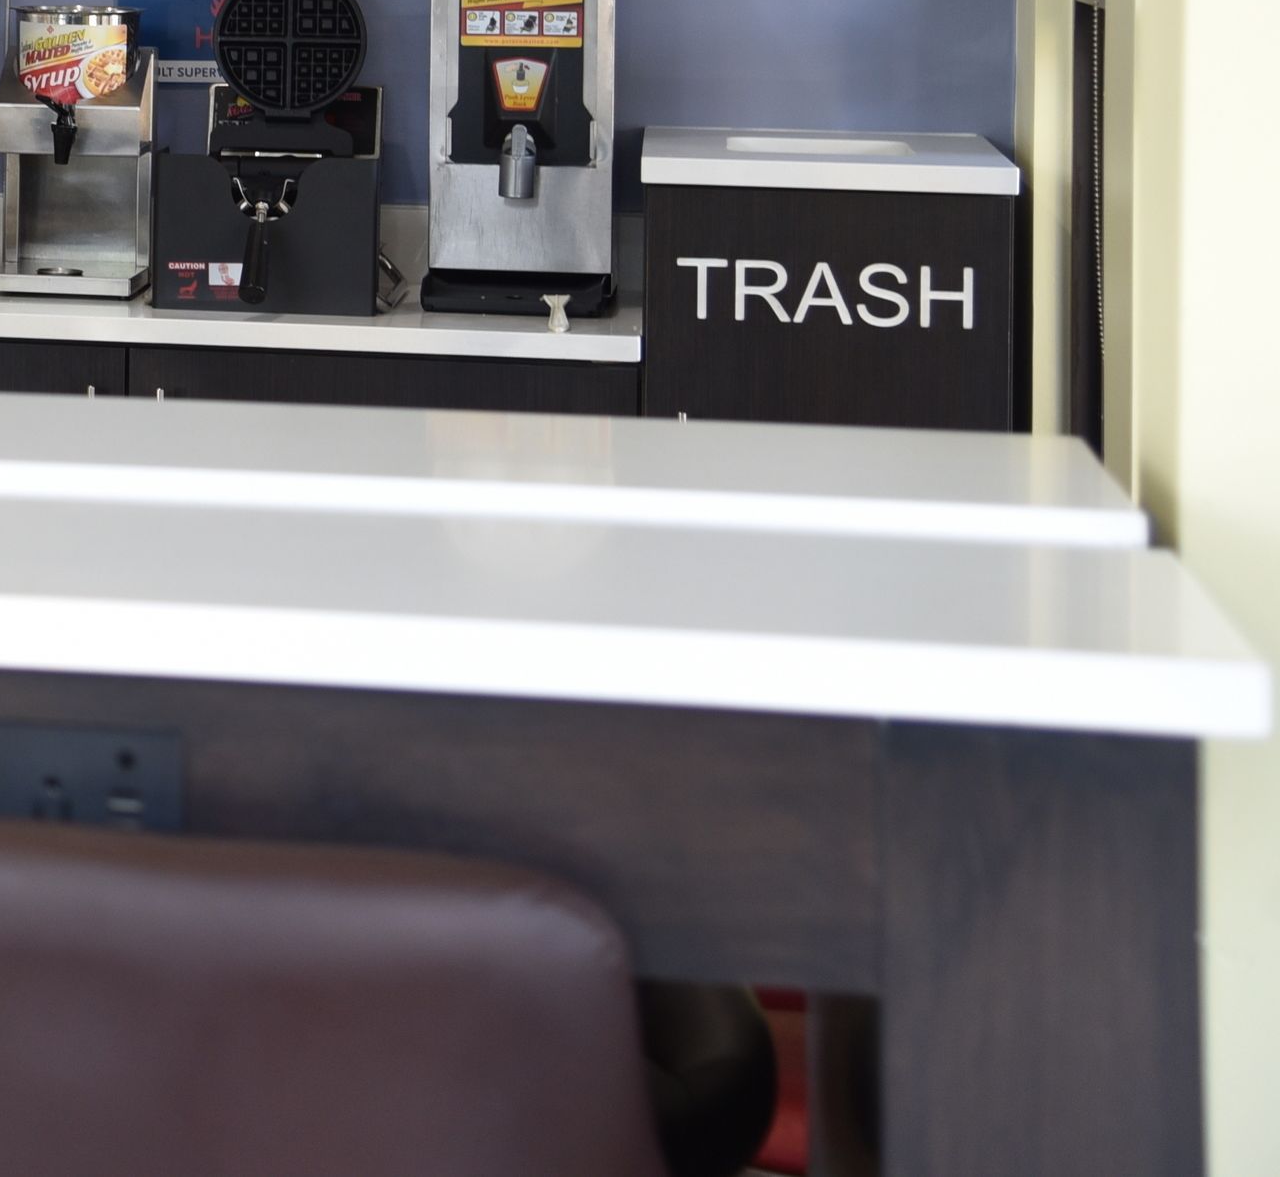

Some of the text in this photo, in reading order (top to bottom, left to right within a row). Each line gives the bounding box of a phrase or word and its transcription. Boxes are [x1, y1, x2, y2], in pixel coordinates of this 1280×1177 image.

[35, 29, 86, 50] GOLDEN
[25, 45, 71, 65] MALTED
[168, 262, 206, 270] CAUTION
[676, 256, 974, 330] TRASH
